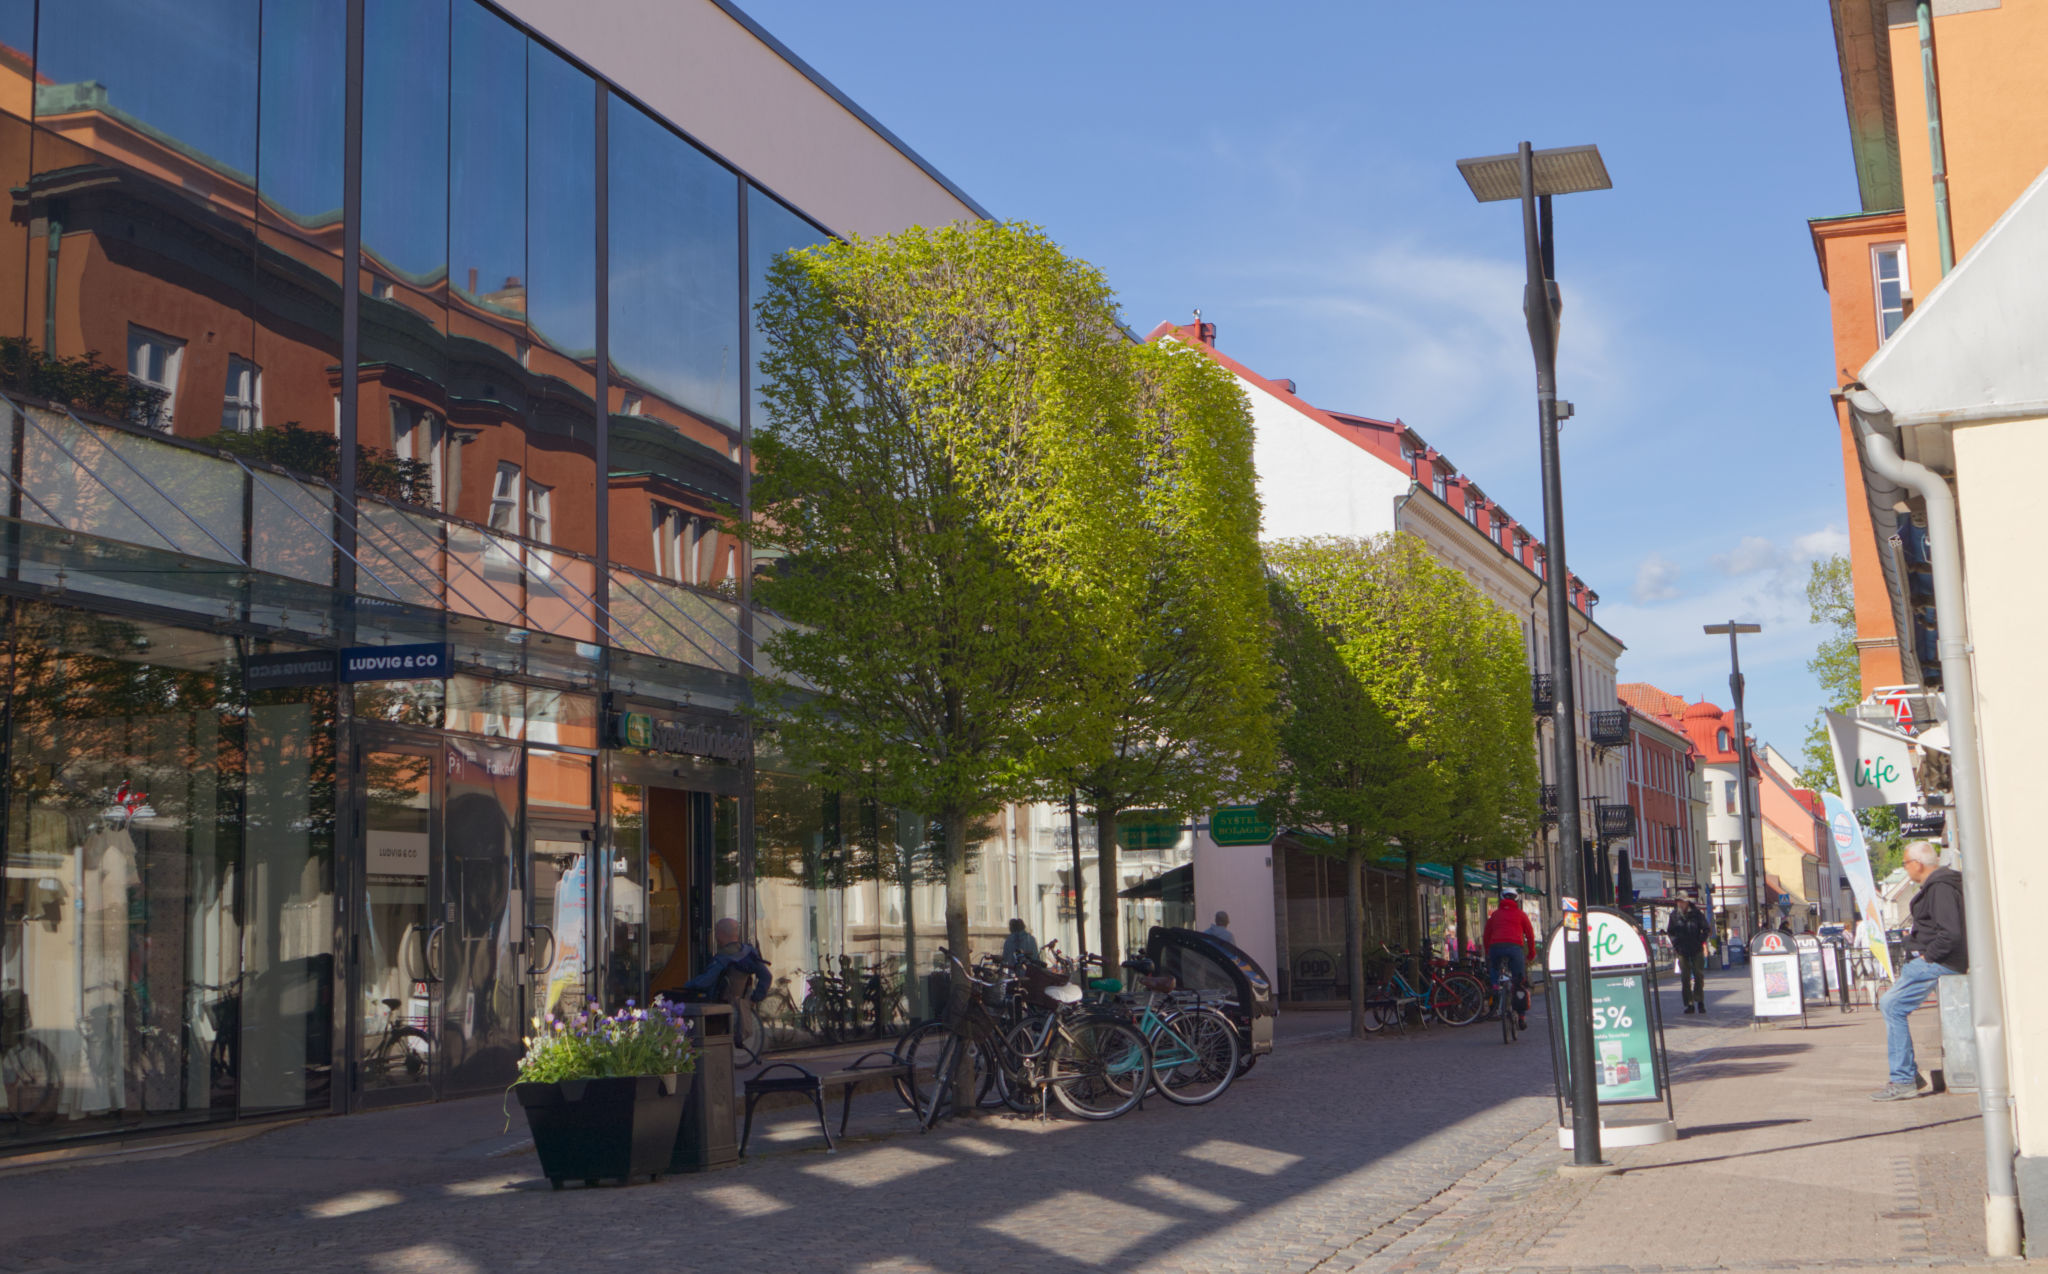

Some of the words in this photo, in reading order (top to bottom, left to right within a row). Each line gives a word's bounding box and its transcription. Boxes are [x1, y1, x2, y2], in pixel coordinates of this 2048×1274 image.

[350, 656, 400, 671] LUDVIG
[404, 656, 413, 668] &
[415, 654, 438, 667] CO
[486, 758, 516, 776] Falken
[1853, 756, 1900, 789] life
[379, 847, 402, 858] LUDVIG
[1592, 1005, 1633, 1030] 5%
